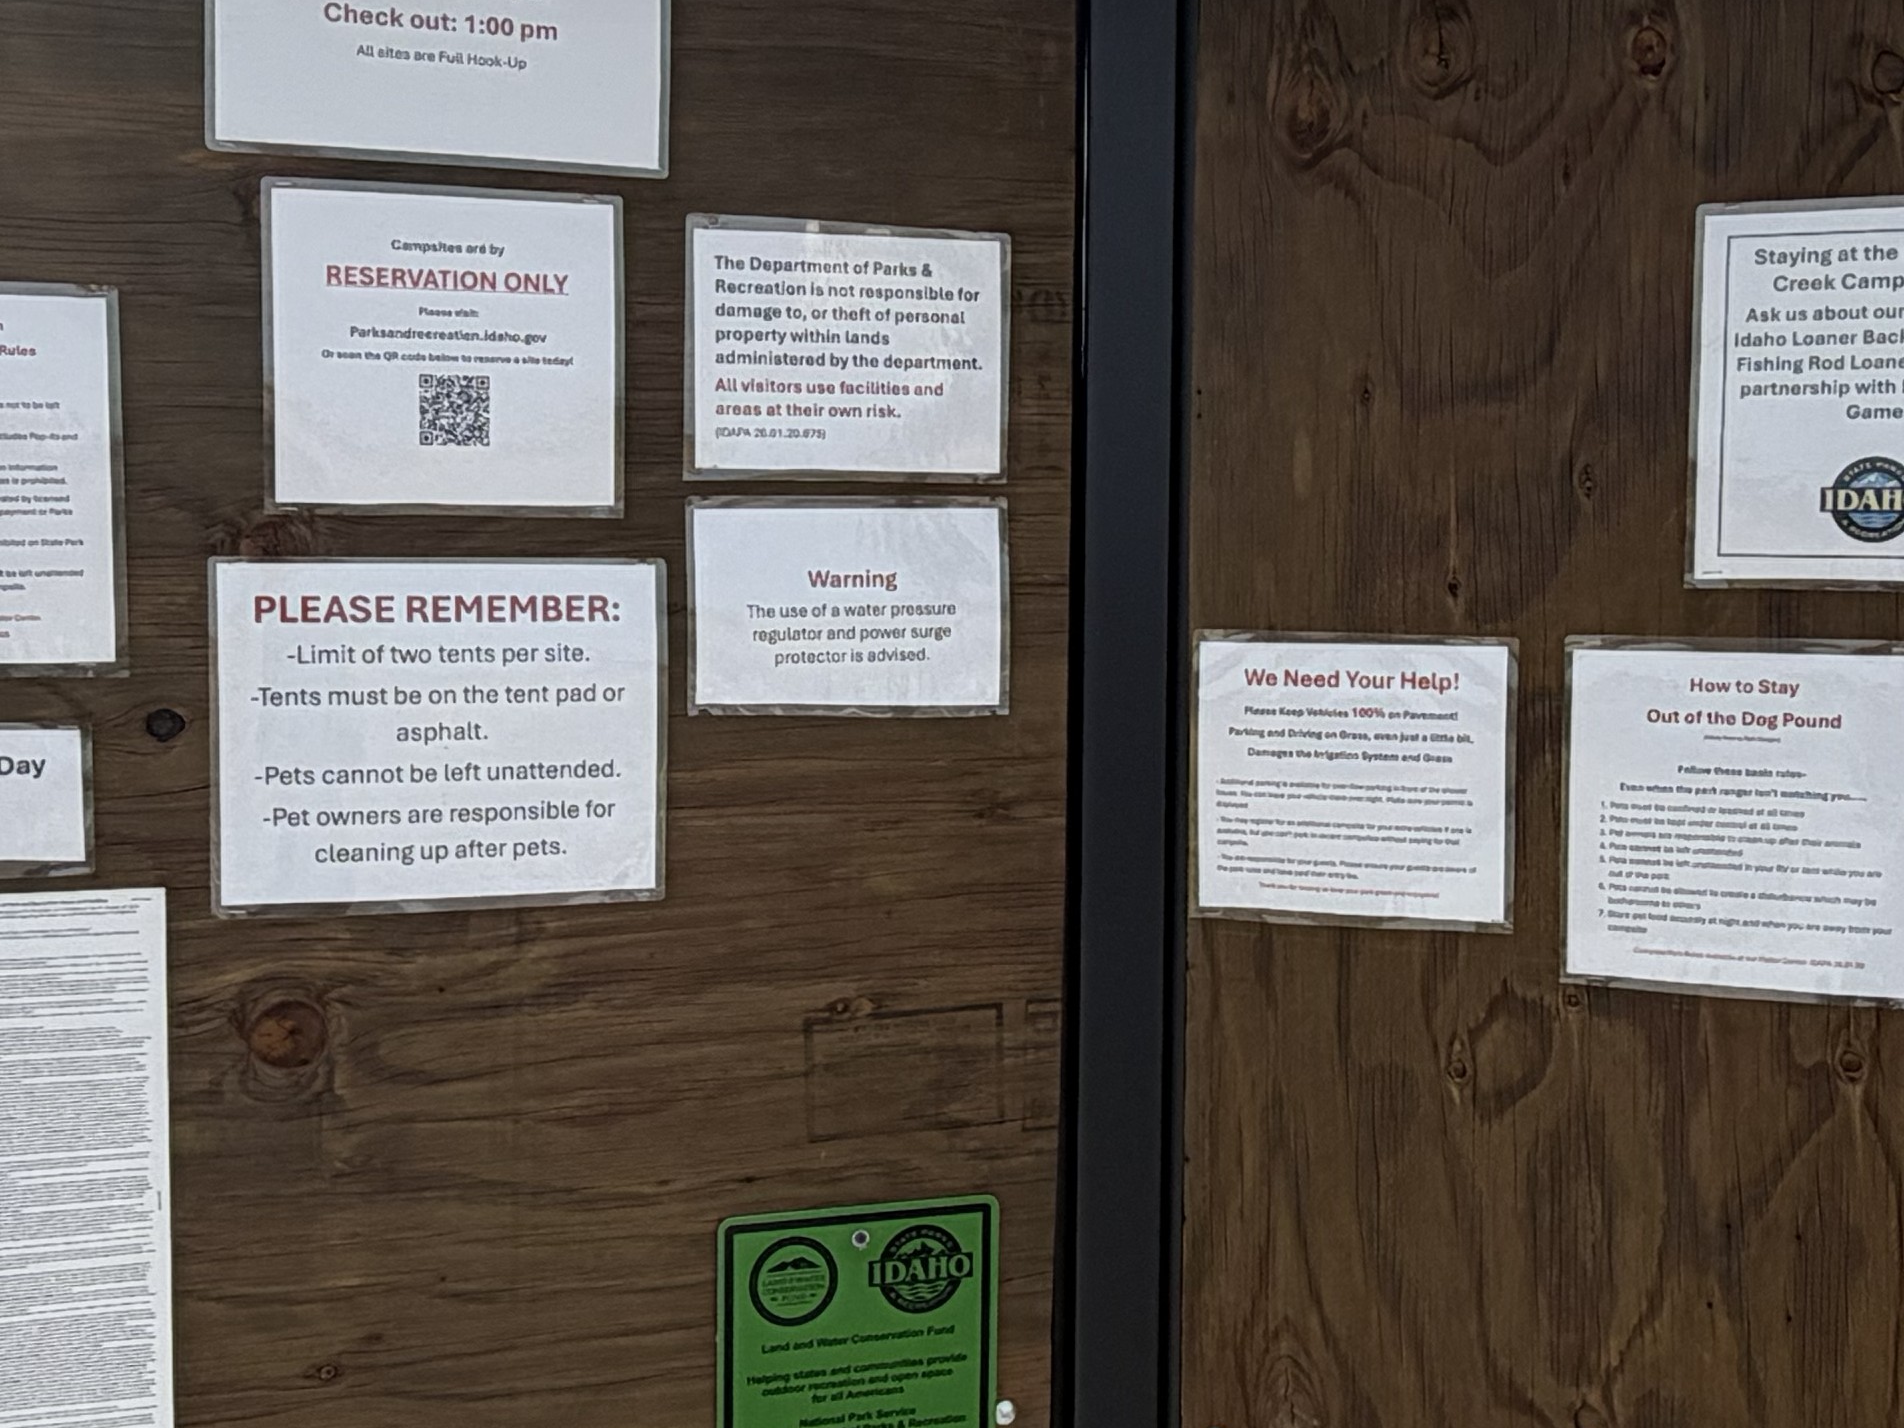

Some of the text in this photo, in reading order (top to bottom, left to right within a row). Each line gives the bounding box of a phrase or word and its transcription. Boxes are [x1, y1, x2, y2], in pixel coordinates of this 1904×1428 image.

[323, 2, 557, 42] Check out: 1:00 pm
[713, 254, 932, 277] The Department of Parks &
[1754, 246, 1832, 267] Staying
[1837, 246, 1857, 262] at
[1863, 244, 1898, 261] the
[326, 264, 568, 293] RESERVATION ONLY
[714, 278, 980, 302] Recreation is not responsible for
[1773, 273, 1835, 292] Creek
[1745, 306, 1780, 322] Ask
[1785, 309, 1807, 321] us
[1812, 305, 1868, 320] about
[1872, 306, 1904, 319] our
[1734, 331, 1787, 347] Idaho
[1792, 331, 1857, 346] Loaner
[1736, 355, 1803, 374] Fishing
[1808, 354, 1844, 370] Rod
[714, 377, 943, 396] All visitors use facilities and
[1739, 379, 1850, 399] partnership
[1854, 378, 1896, 394] with
[715, 402, 901, 418] areas at their own risk.
[807, 568, 897, 591] Warning
[254, 594, 619, 623] PLEASE REMEMBER:
[746, 603, 956, 618] The use of a water pressure
[286, 642, 589, 667] -Limit of two tents per site.
[774, 647, 929, 667] protector is advised.
[1244, 668, 1458, 694] We Need Your Help!
[1689, 677, 1799, 698] How to Stay
[250, 682, 625, 706] -Tents must be on the tent pad or
[1646, 708, 1841, 730] Out of the Dog Pound
[396, 721, 488, 745] asphalt.
[254, 758, 620, 785] -Pets cannot be left unattended.
[262, 799, 615, 826] -Pet owners are responsible for
[314, 838, 566, 865] cleaning up after pets.
[871, 1254, 971, 1286] IDAHO
